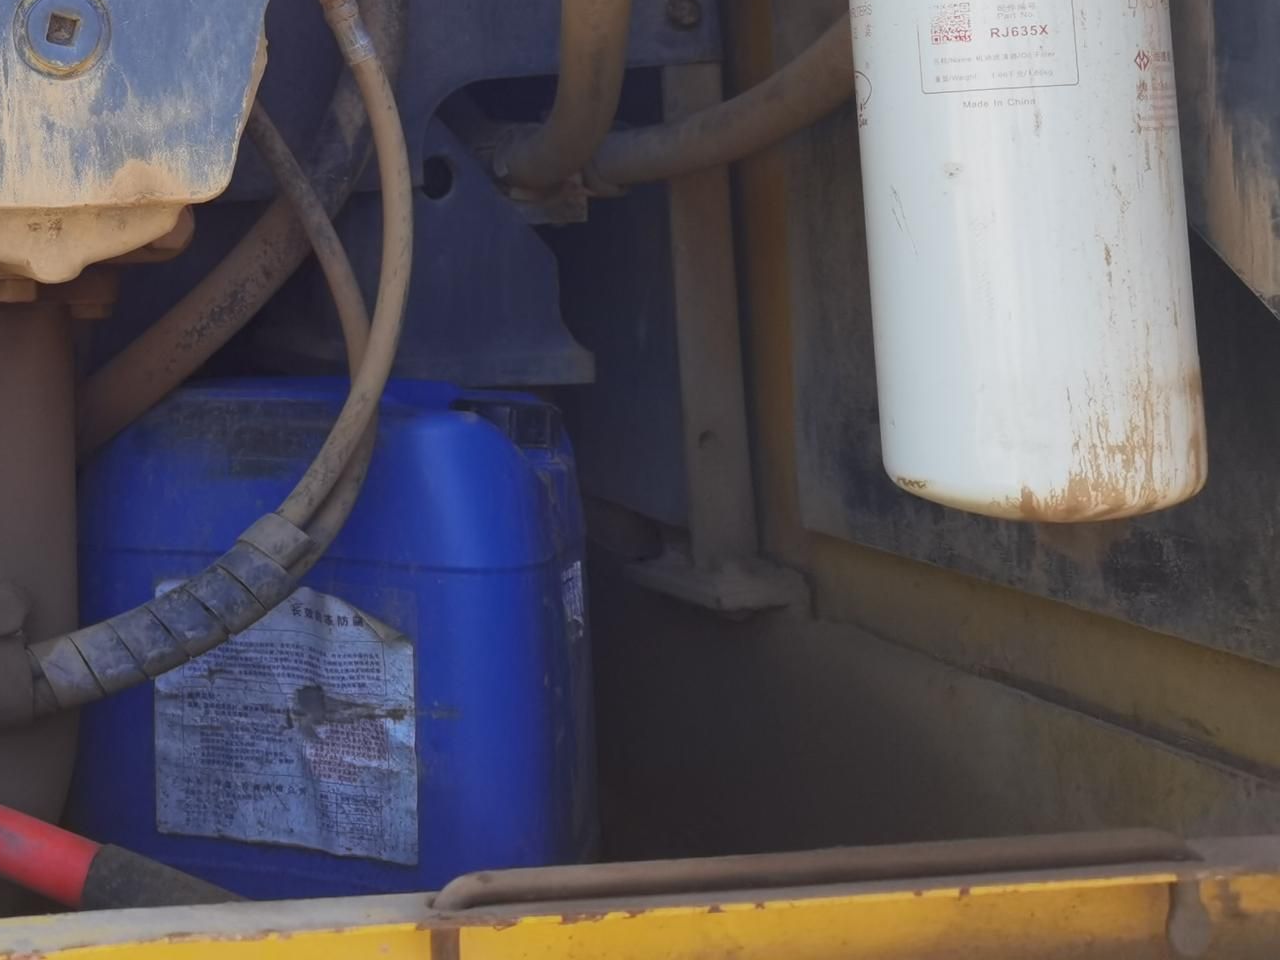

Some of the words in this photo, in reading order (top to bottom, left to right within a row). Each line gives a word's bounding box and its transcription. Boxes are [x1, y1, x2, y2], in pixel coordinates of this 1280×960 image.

[990, 24, 1049, 39] RJ635X
[962, 101, 990, 110] Made
[1007, 97, 1037, 107] China
